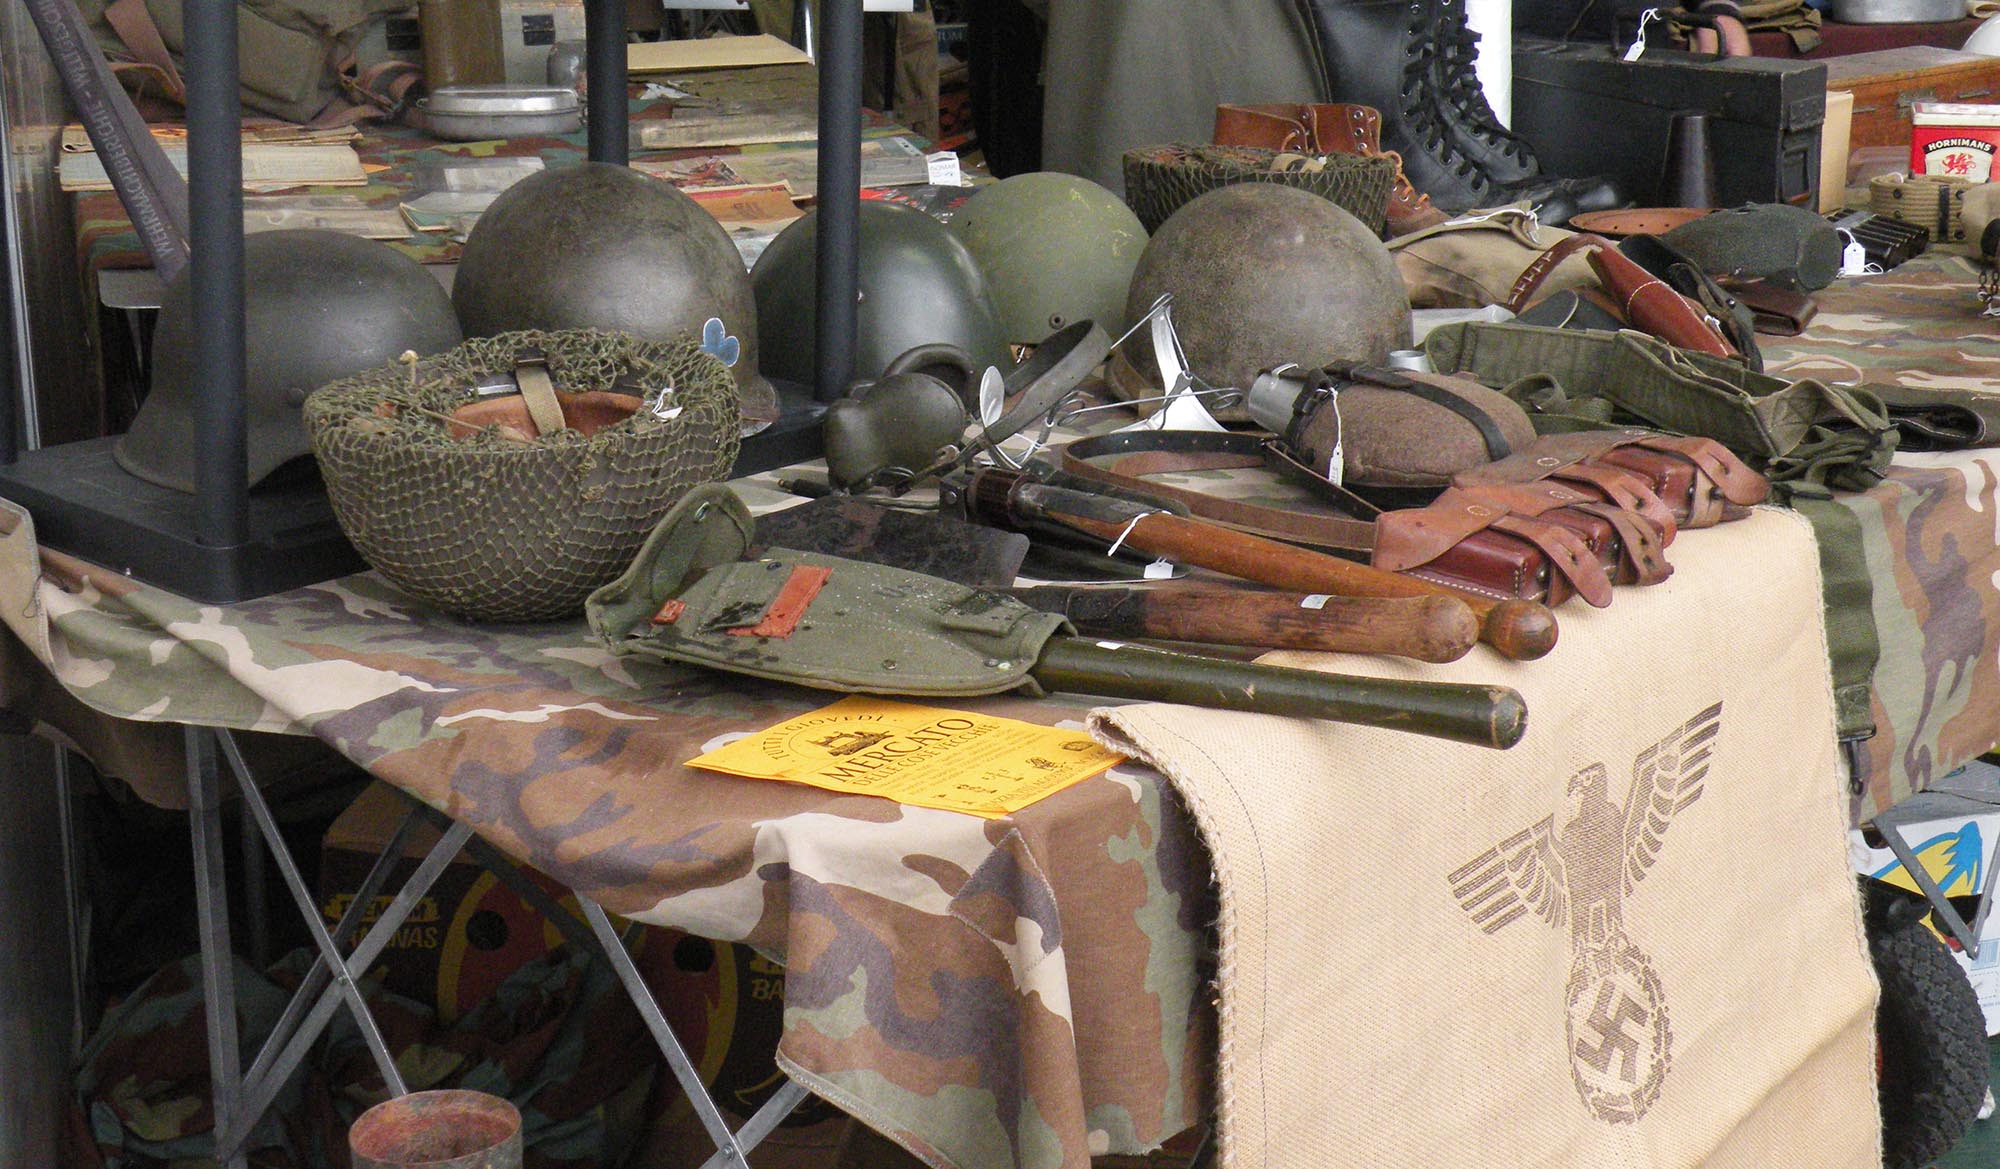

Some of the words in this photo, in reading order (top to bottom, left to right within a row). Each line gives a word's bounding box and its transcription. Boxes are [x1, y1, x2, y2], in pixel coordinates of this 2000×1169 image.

[1928, 139, 1992, 152] HORNIMANS
[820, 719, 974, 783] MERCATO
[853, 764, 901, 785] DELLE
[897, 750, 938, 768] COSE
[933, 723, 1001, 751] VECCHIE
